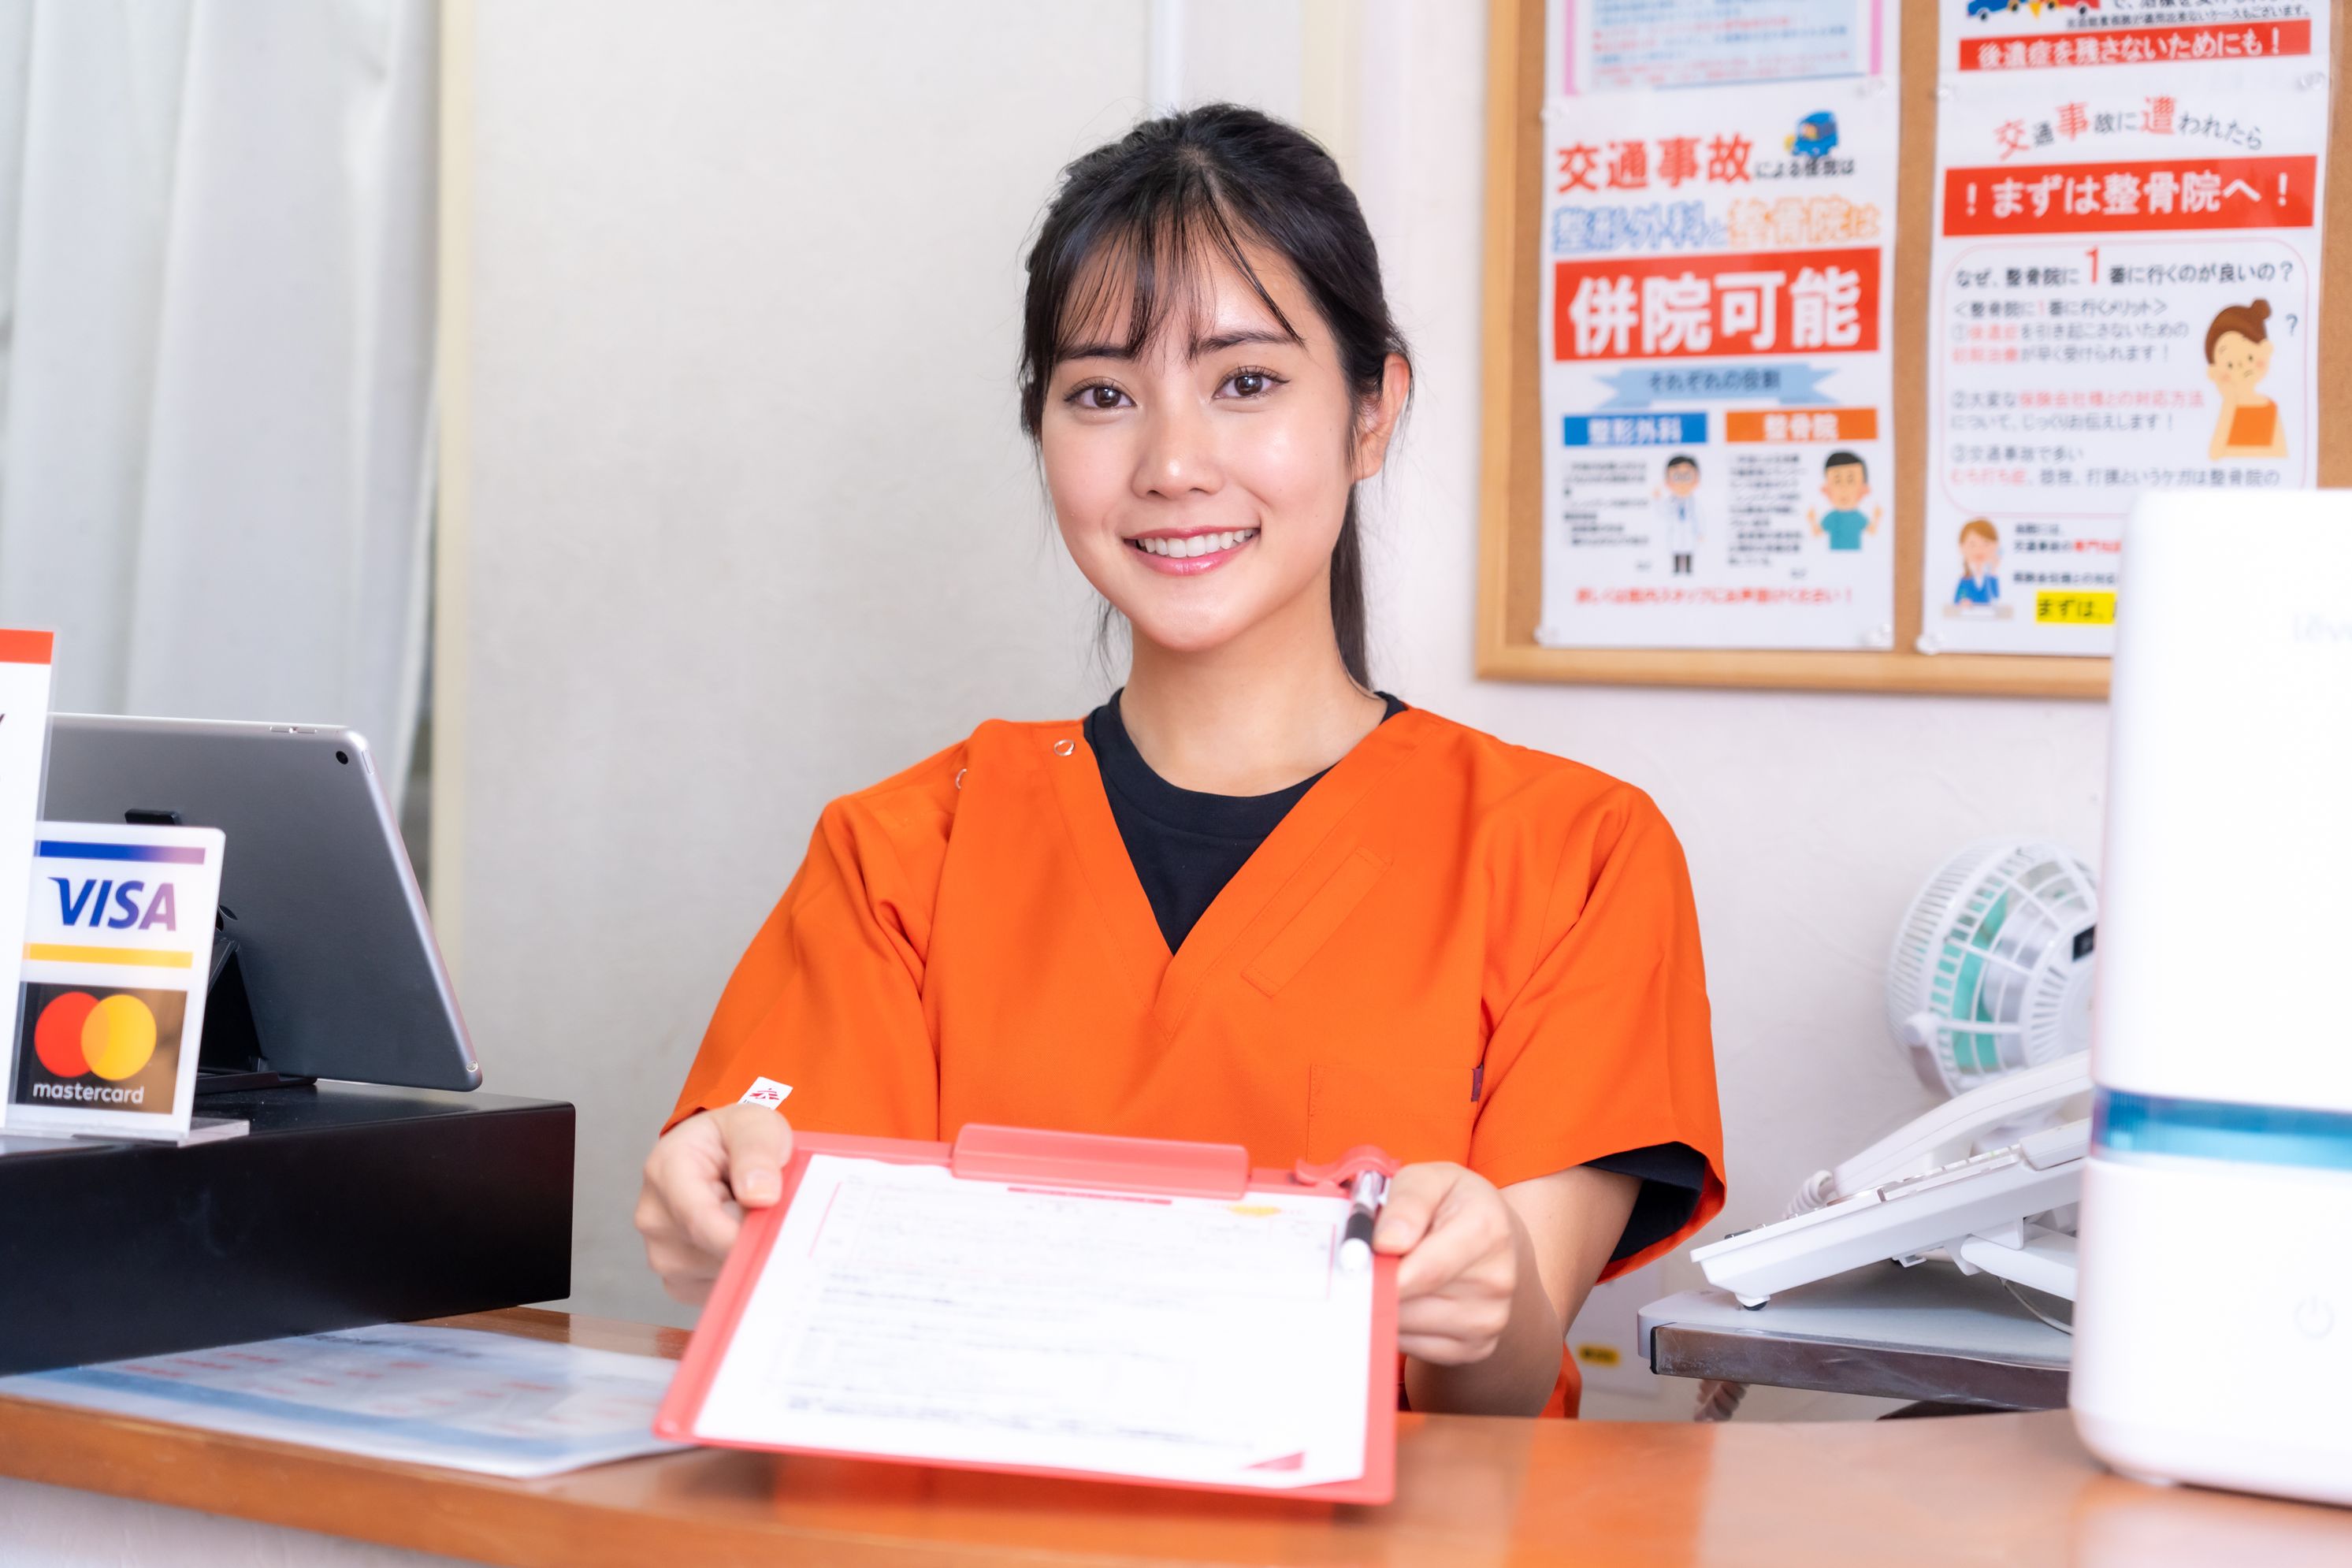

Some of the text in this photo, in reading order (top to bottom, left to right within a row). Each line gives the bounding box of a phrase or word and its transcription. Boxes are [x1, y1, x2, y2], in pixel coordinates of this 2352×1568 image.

[1979, 28, 2280, 69] 後遺症を残さないためにも！
[1994, 95, 2262, 160] 交通事故に遭われたら
[1568, 266, 1861, 355] 併院可能
[1649, 367, 1782, 392] それぞれの役割
[1587, 416, 1683, 446] 整形外科
[1763, 412, 1840, 443] 整骨院
[47, 877, 177, 931] VISA
[32, 1083, 144, 1104] mastercard
